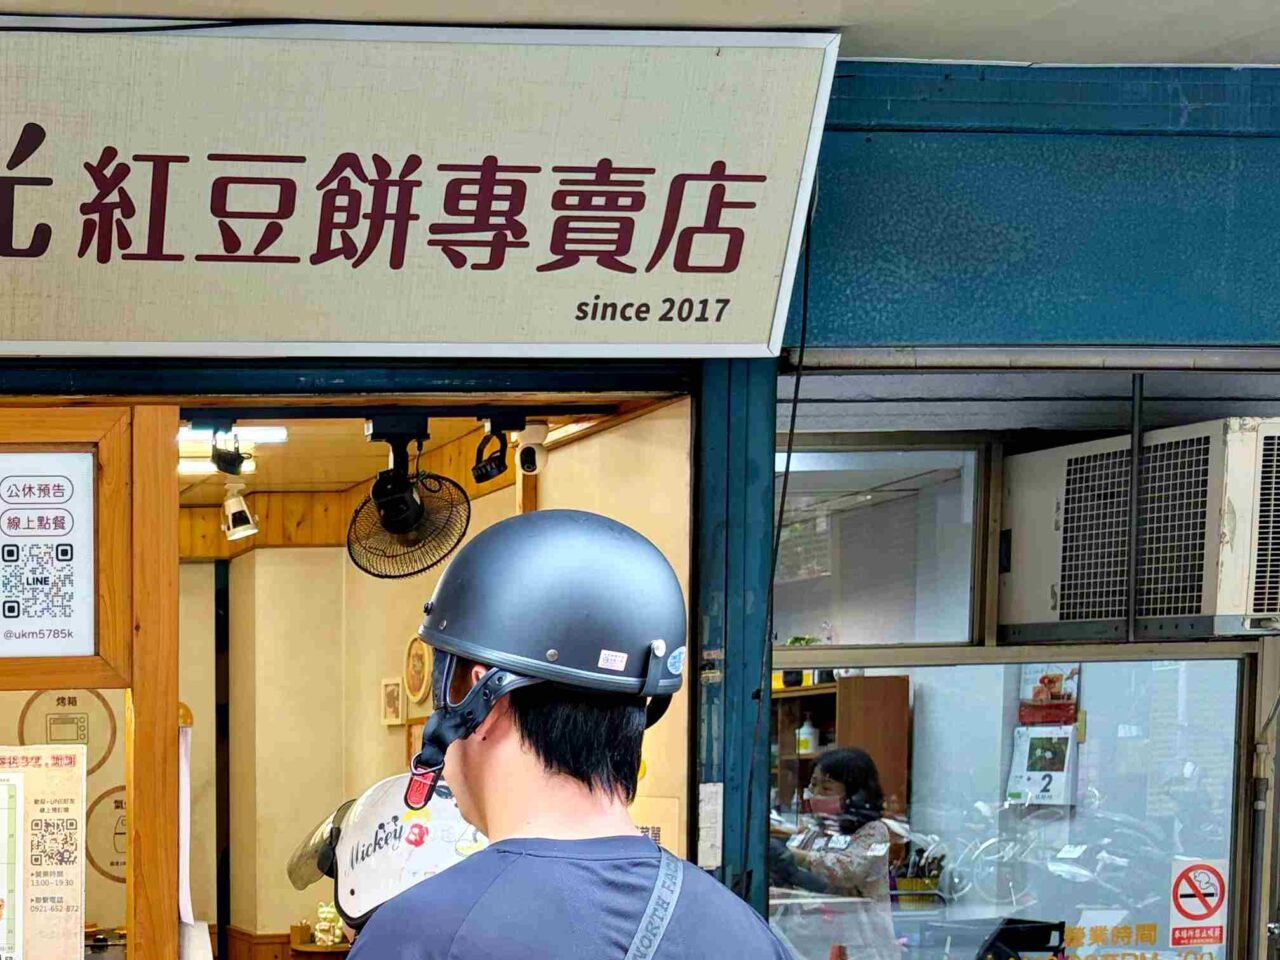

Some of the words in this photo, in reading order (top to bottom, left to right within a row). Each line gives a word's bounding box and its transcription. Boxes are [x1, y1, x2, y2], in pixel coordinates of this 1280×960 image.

[575, 296, 651, 323] since
[658, 296, 731, 323] 2017
[6, 483, 65, 498] 公休預告
[7, 516, 66, 531] 線上點餐
[26, 577, 50, 586] LINE
[3, 629, 74, 640] @ukm5785k
[1040, 773, 1053, 793] 2
[350, 822, 404, 871] Mickey
[1064, 923, 1158, 948] 營業時間
